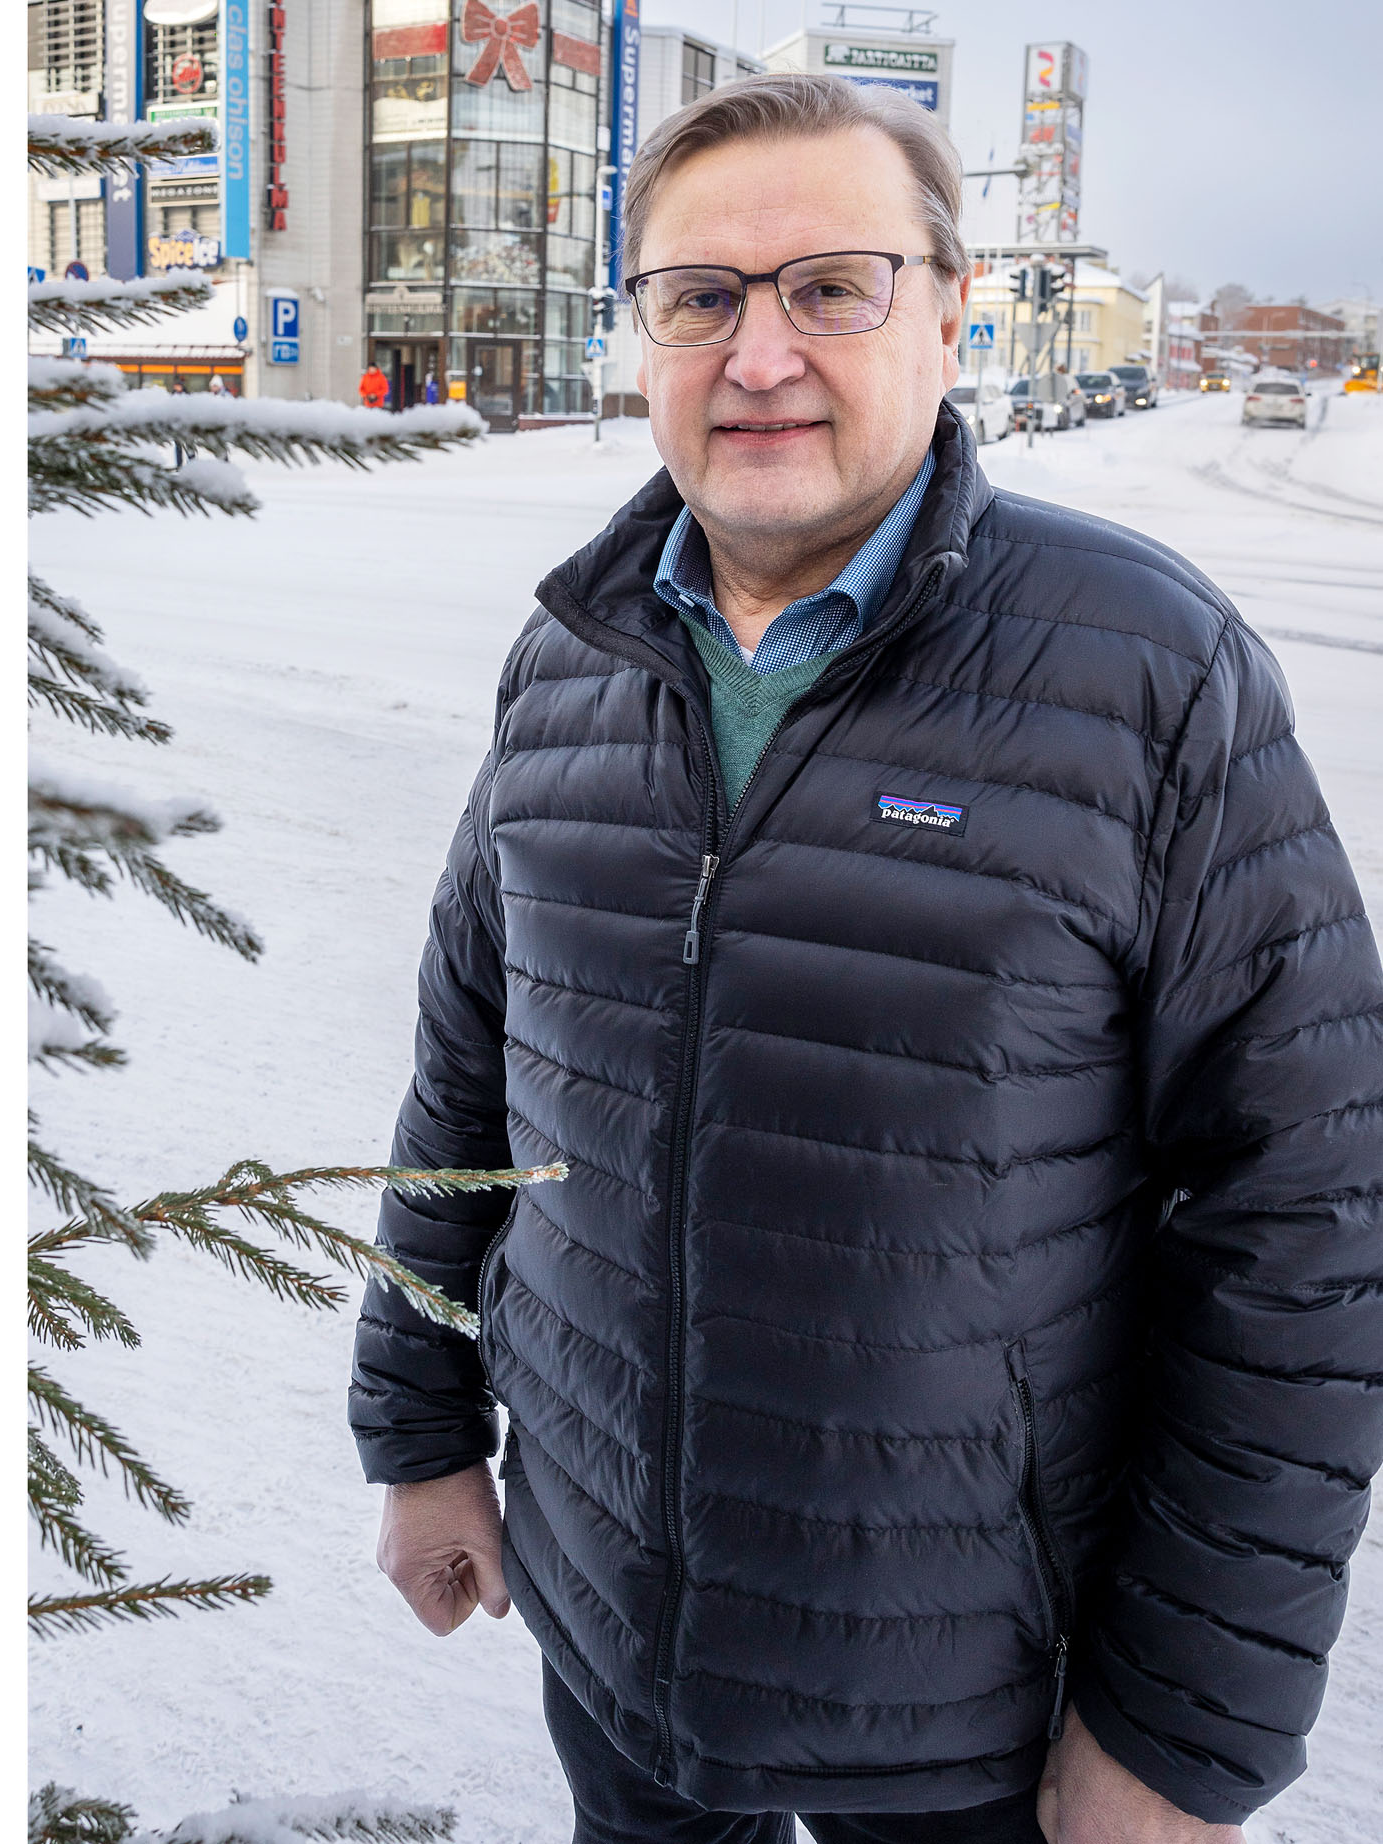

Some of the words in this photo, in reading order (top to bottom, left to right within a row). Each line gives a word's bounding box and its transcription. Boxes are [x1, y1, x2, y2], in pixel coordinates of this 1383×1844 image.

[227, 4, 247, 71] clas
[227, 76, 247, 180] ohlson
[272, 0, 288, 231] NTEENKULMA
[148, 236, 194, 270] Spice
[193, 236, 219, 267] Ice
[277, 300, 297, 336] P
[880, 806, 954, 828] patagonia
